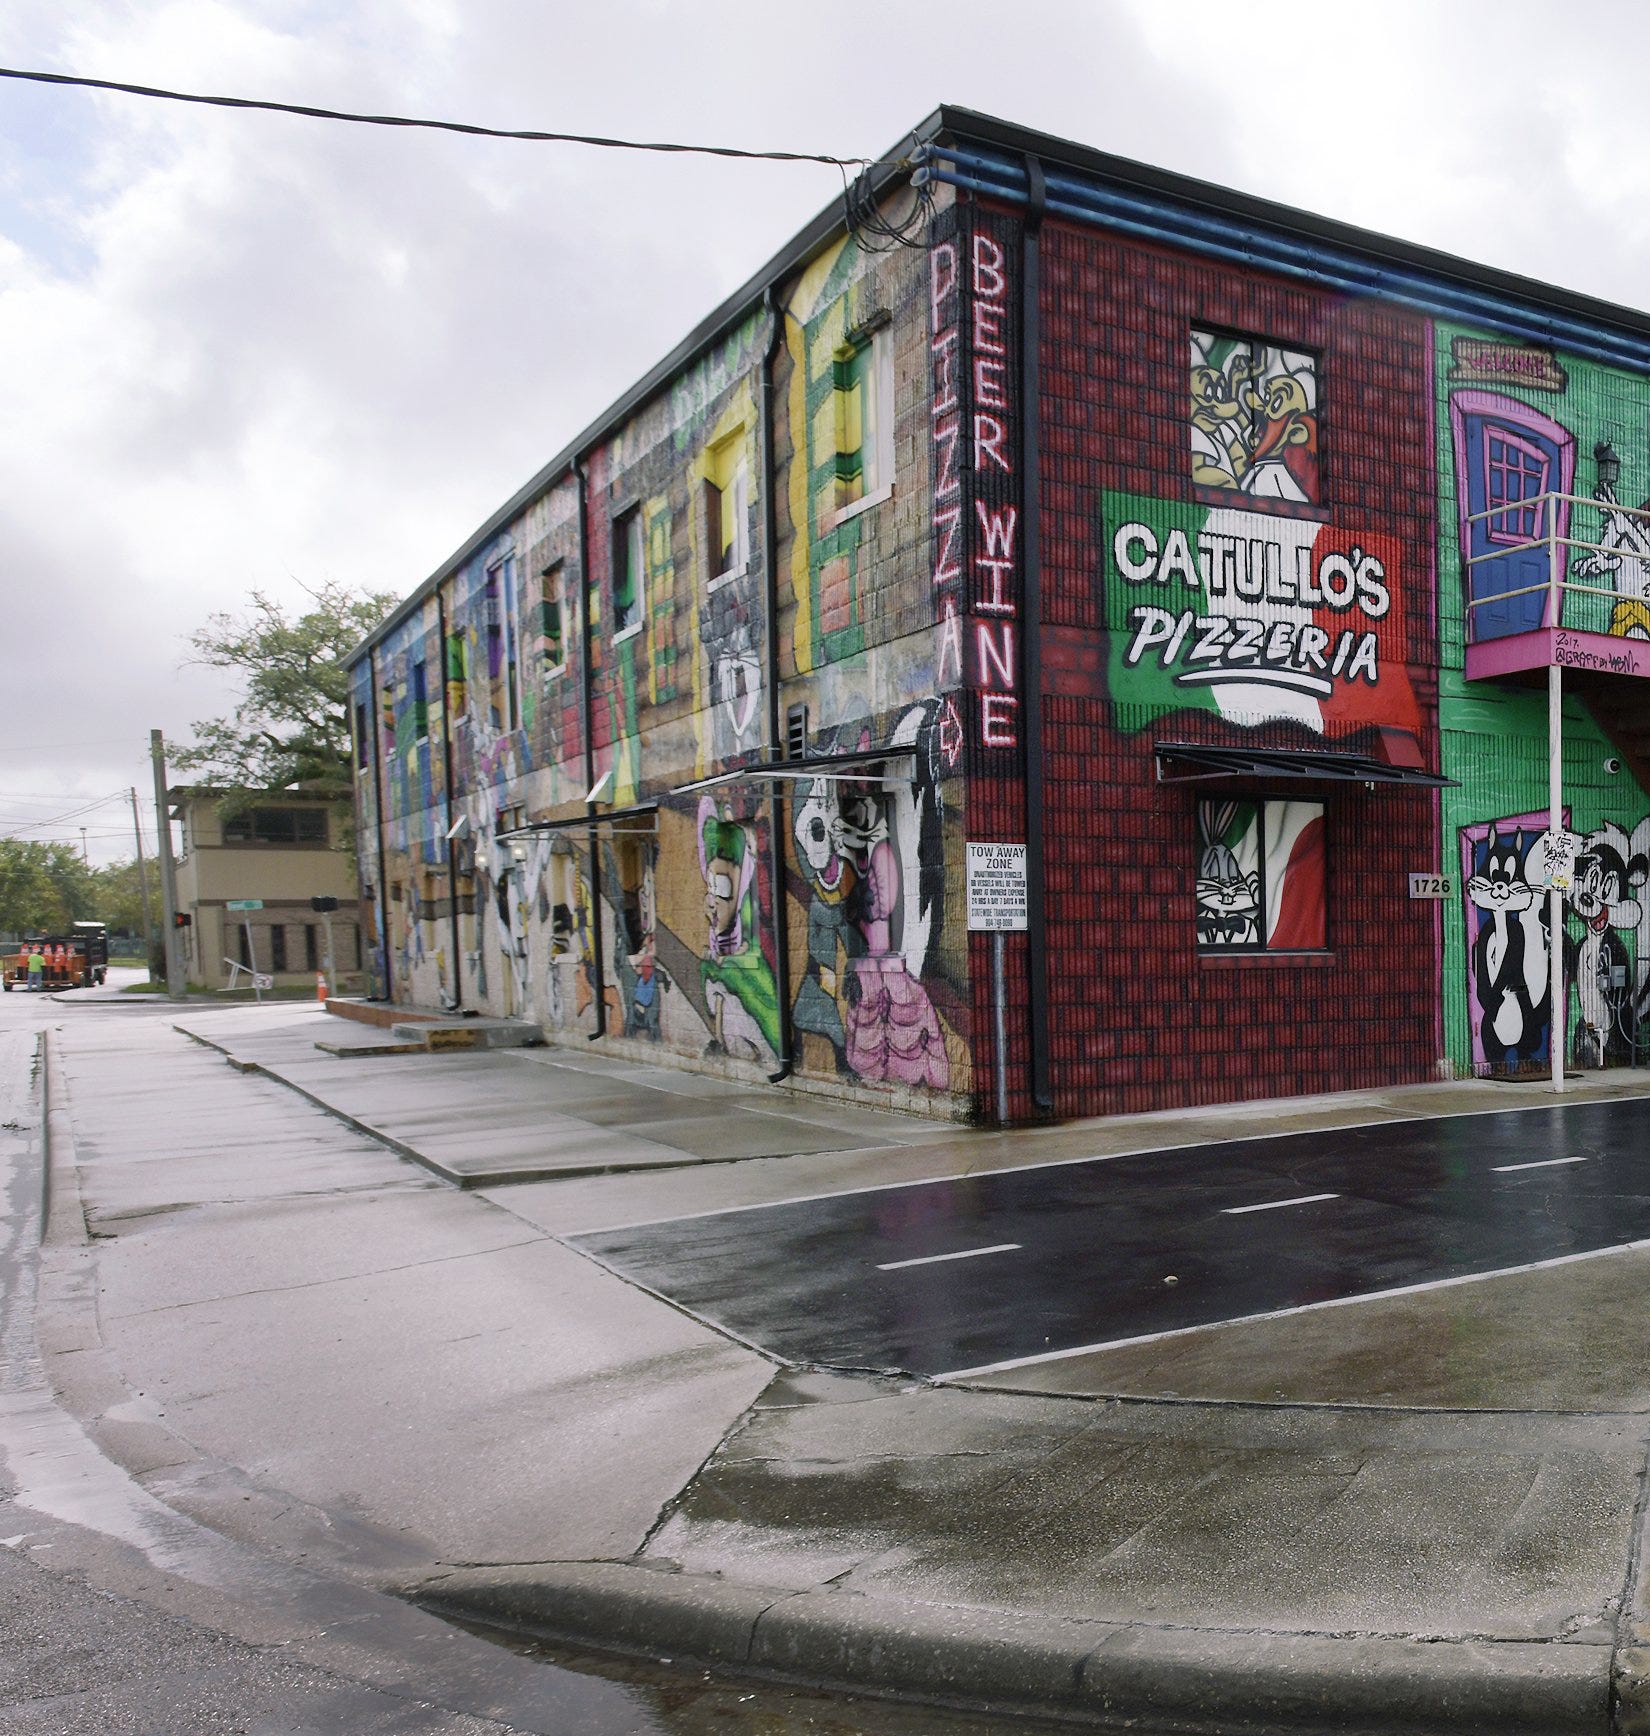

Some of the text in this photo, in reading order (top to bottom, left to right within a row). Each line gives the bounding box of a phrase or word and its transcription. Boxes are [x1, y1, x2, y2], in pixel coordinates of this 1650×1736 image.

[931, 243, 961, 683] PIZZA
[973, 235, 1017, 747] BEER WINE
[1114, 523, 1391, 618] CATULLO'S
[1128, 606, 1377, 682] PIZZERIA
[971, 846, 1024, 858] TOW AWAY
[986, 858, 1012, 869] ZONE
[1414, 879, 1450, 893] 1726
